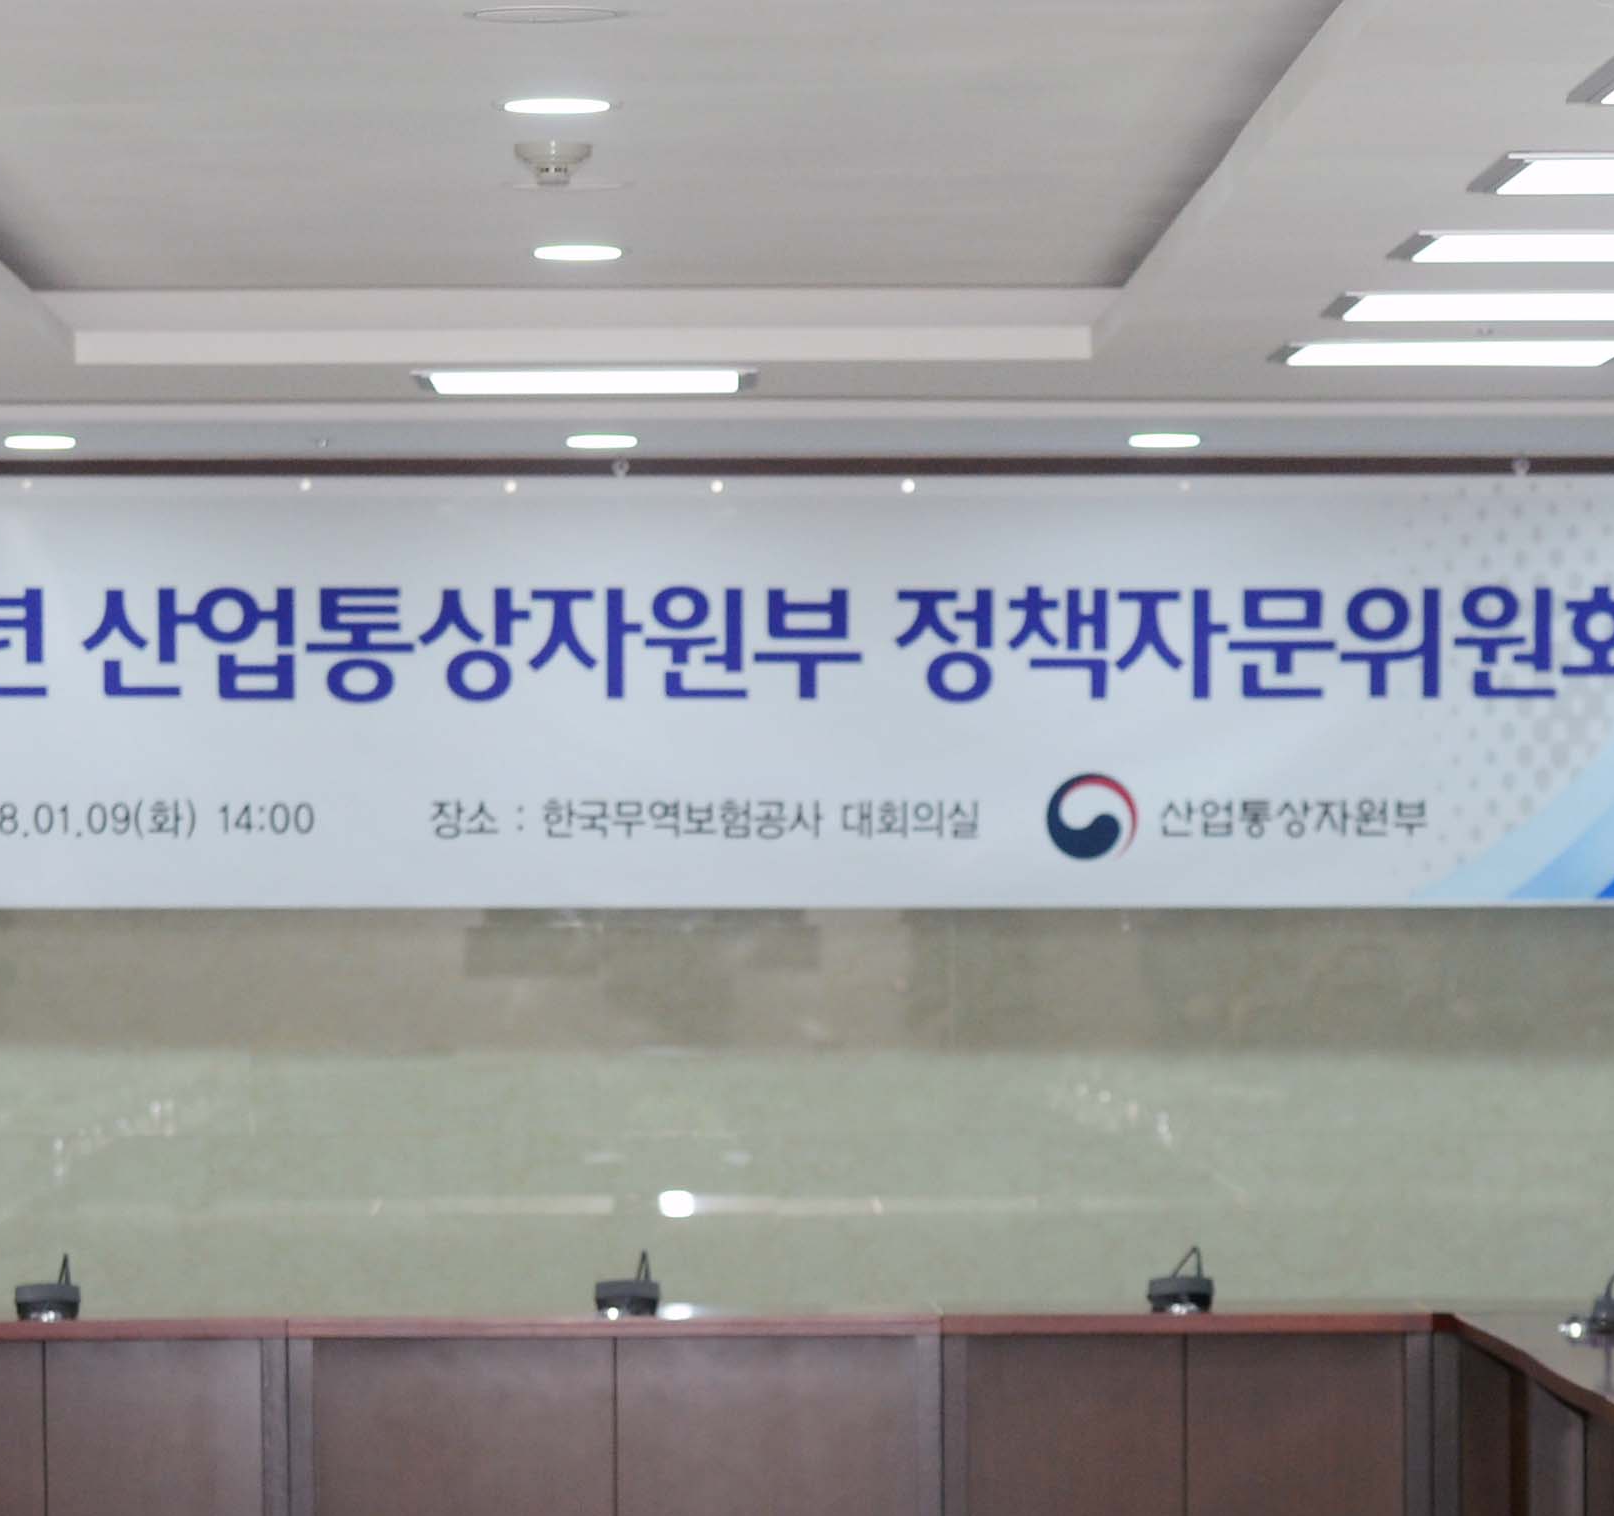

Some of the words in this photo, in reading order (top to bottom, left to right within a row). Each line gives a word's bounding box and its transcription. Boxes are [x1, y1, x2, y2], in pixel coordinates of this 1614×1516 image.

[82, 586, 863, 704] 산업통상자원부
[218, 802, 316, 836] 14:00
[431, 800, 499, 840] 장소
[543, 799, 823, 840] 한국무역보험공사
[841, 800, 980, 840] 대회의실
[1161, 798, 1429, 840] 산업통상자원부
